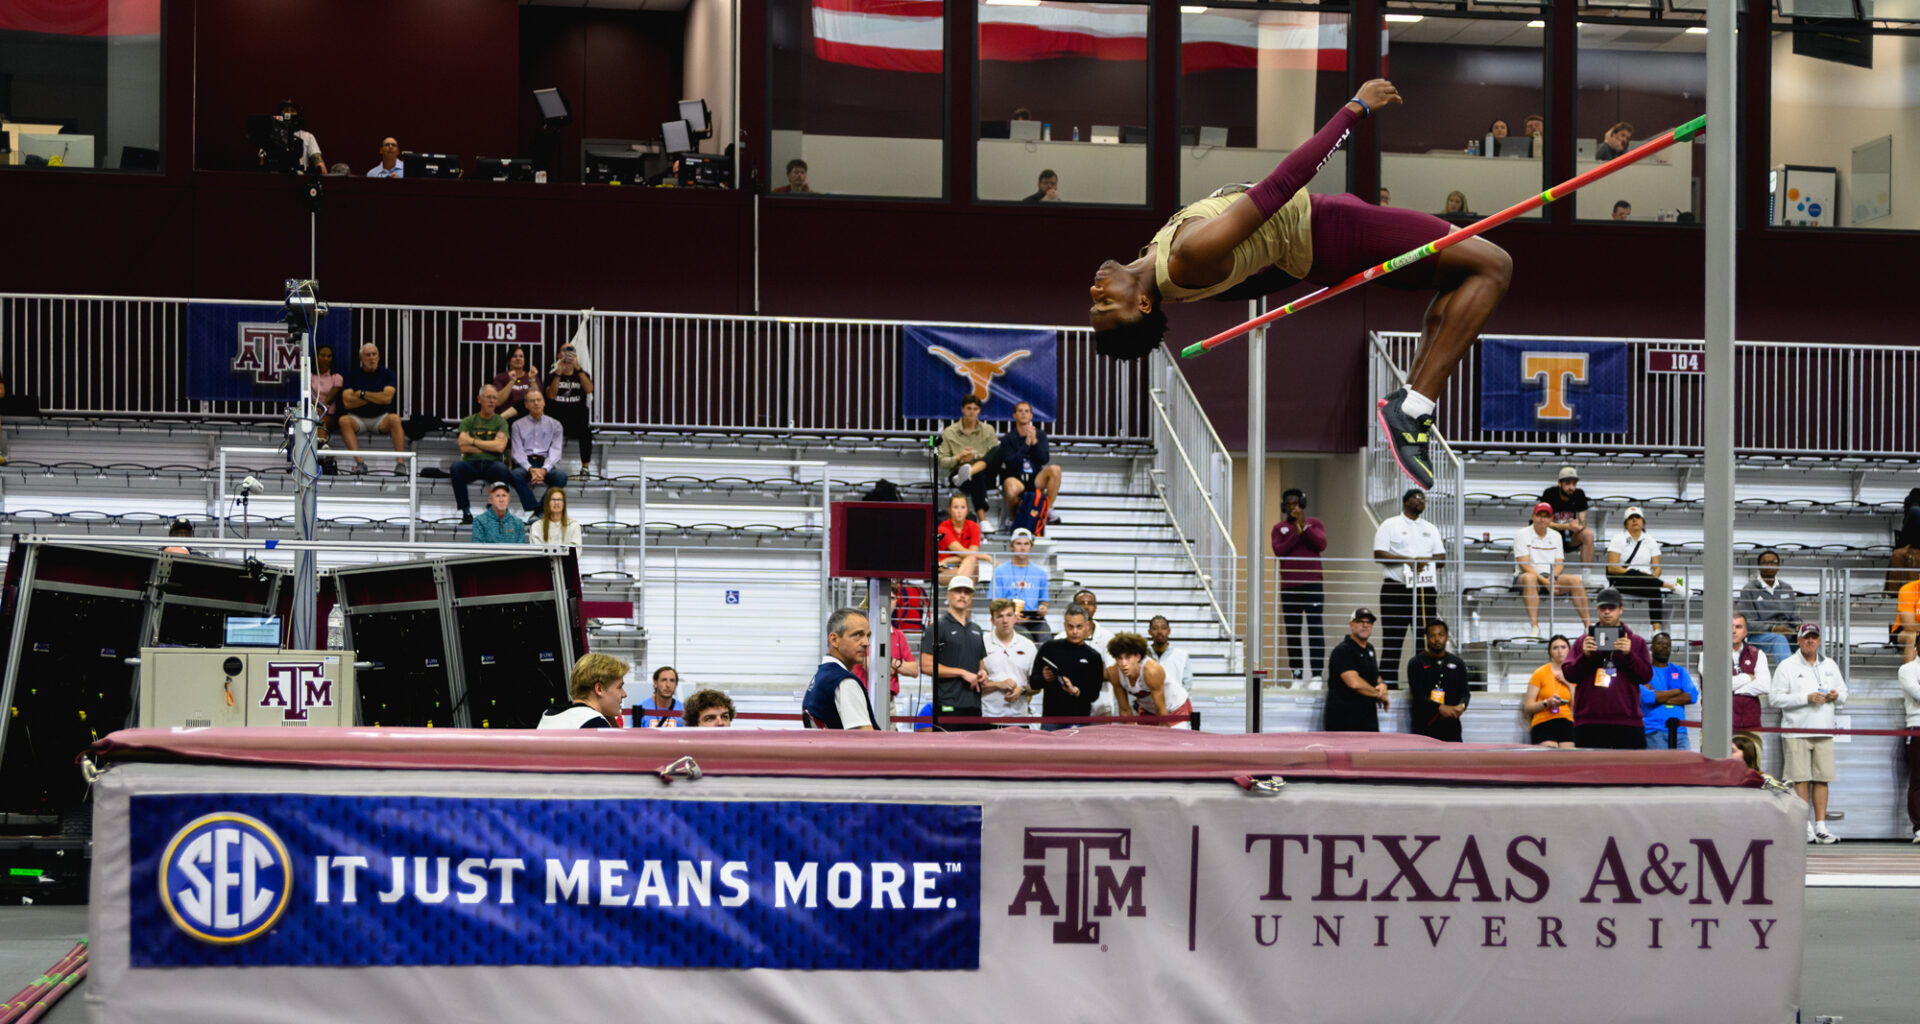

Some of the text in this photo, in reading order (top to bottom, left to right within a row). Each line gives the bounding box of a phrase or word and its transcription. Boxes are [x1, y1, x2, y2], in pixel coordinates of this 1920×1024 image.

[487, 322, 516, 340] 103
[1523, 352, 1588, 420] T
[1671, 353, 1699, 371] 104
[178, 828, 275, 929] SEC
[315, 856, 368, 903] IT
[378, 857, 525, 904] JUST
[545, 858, 749, 907] MEANS
[1245, 833, 1774, 905] TEXAS A&M
[1251, 915, 1777, 949] UNIVERSITY
